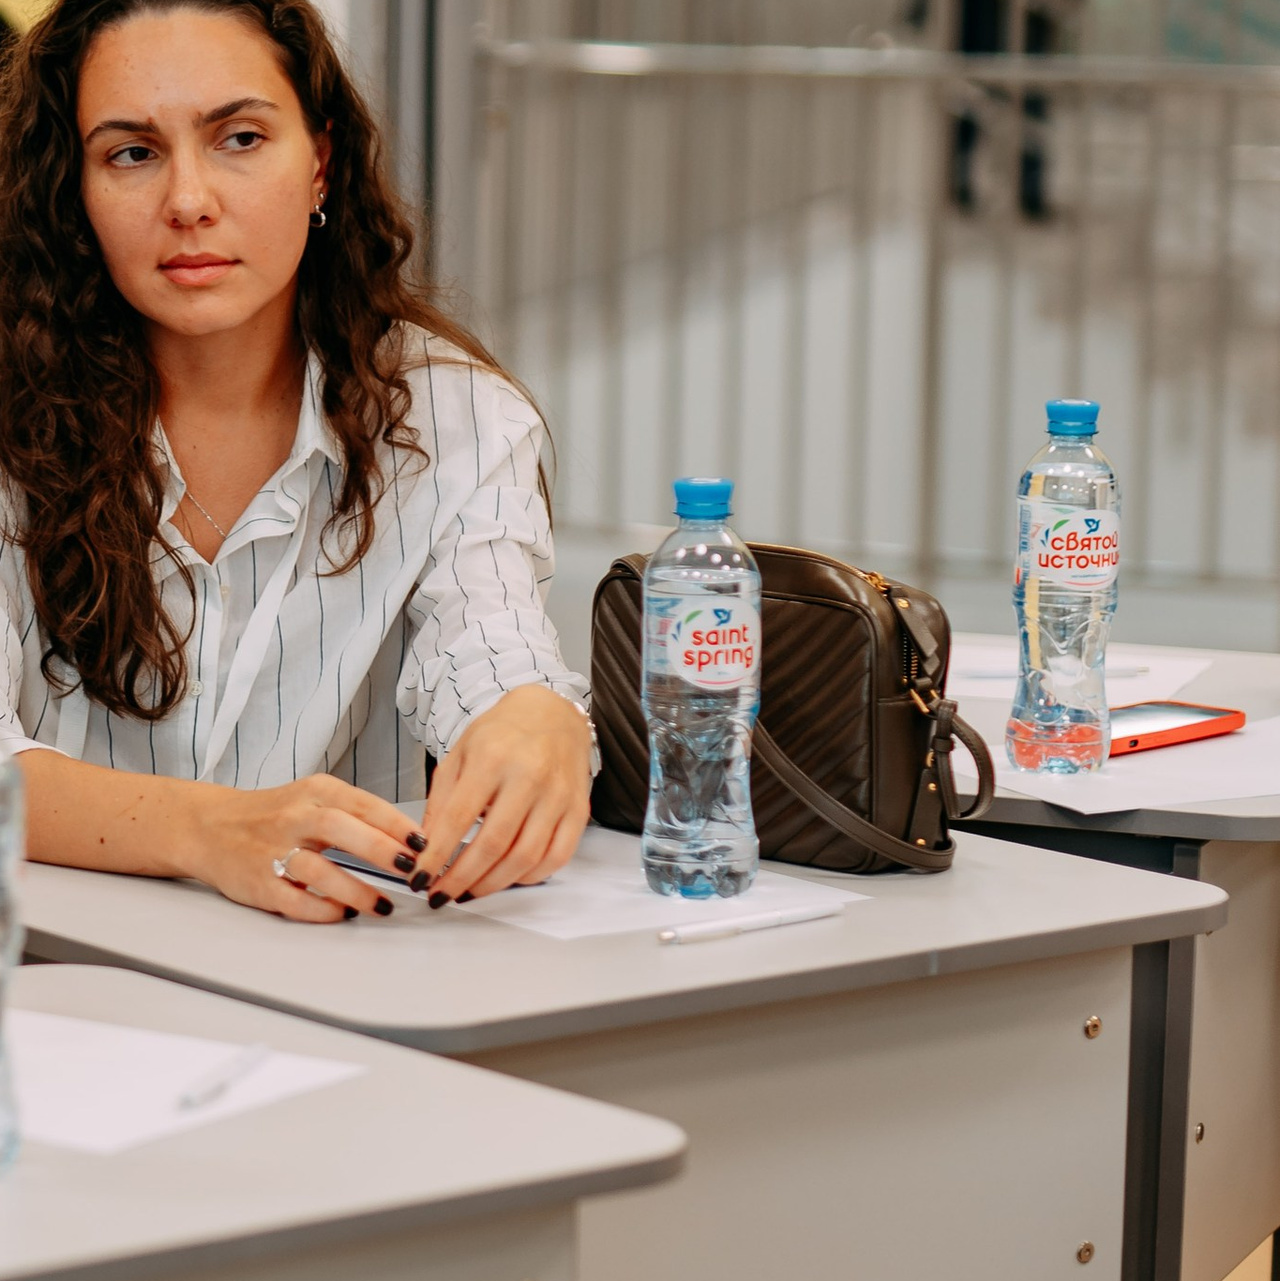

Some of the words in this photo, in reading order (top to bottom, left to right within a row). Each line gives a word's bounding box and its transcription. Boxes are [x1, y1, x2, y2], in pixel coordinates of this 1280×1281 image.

[1038, 552, 1120, 569] источни
[691, 624, 749, 646] saint
[683, 645, 754, 672] spring
